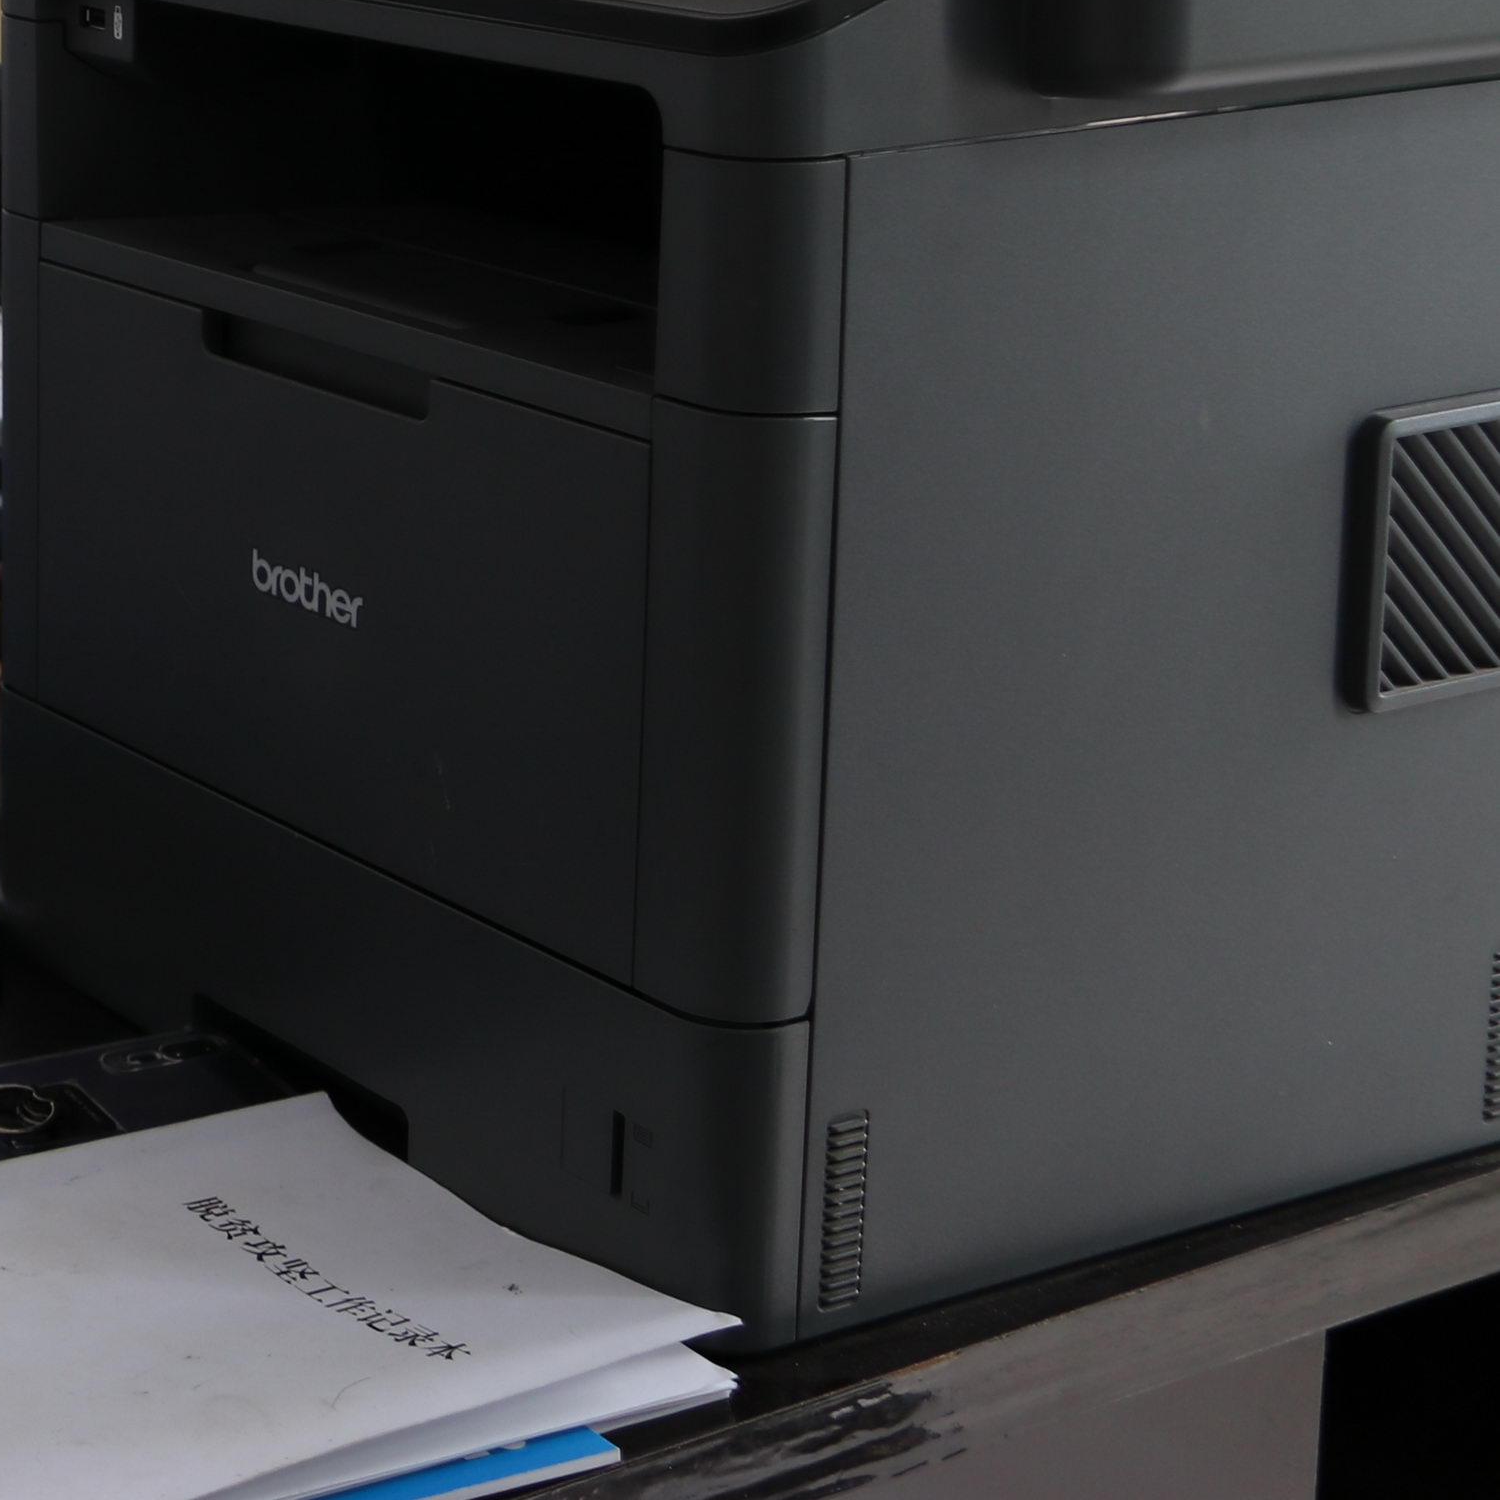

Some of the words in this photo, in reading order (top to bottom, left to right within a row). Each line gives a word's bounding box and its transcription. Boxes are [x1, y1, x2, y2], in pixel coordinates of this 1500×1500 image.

[252, 548, 363, 628] brother
[182, 1196, 471, 1361] 脱贫攻坚工作记录本
